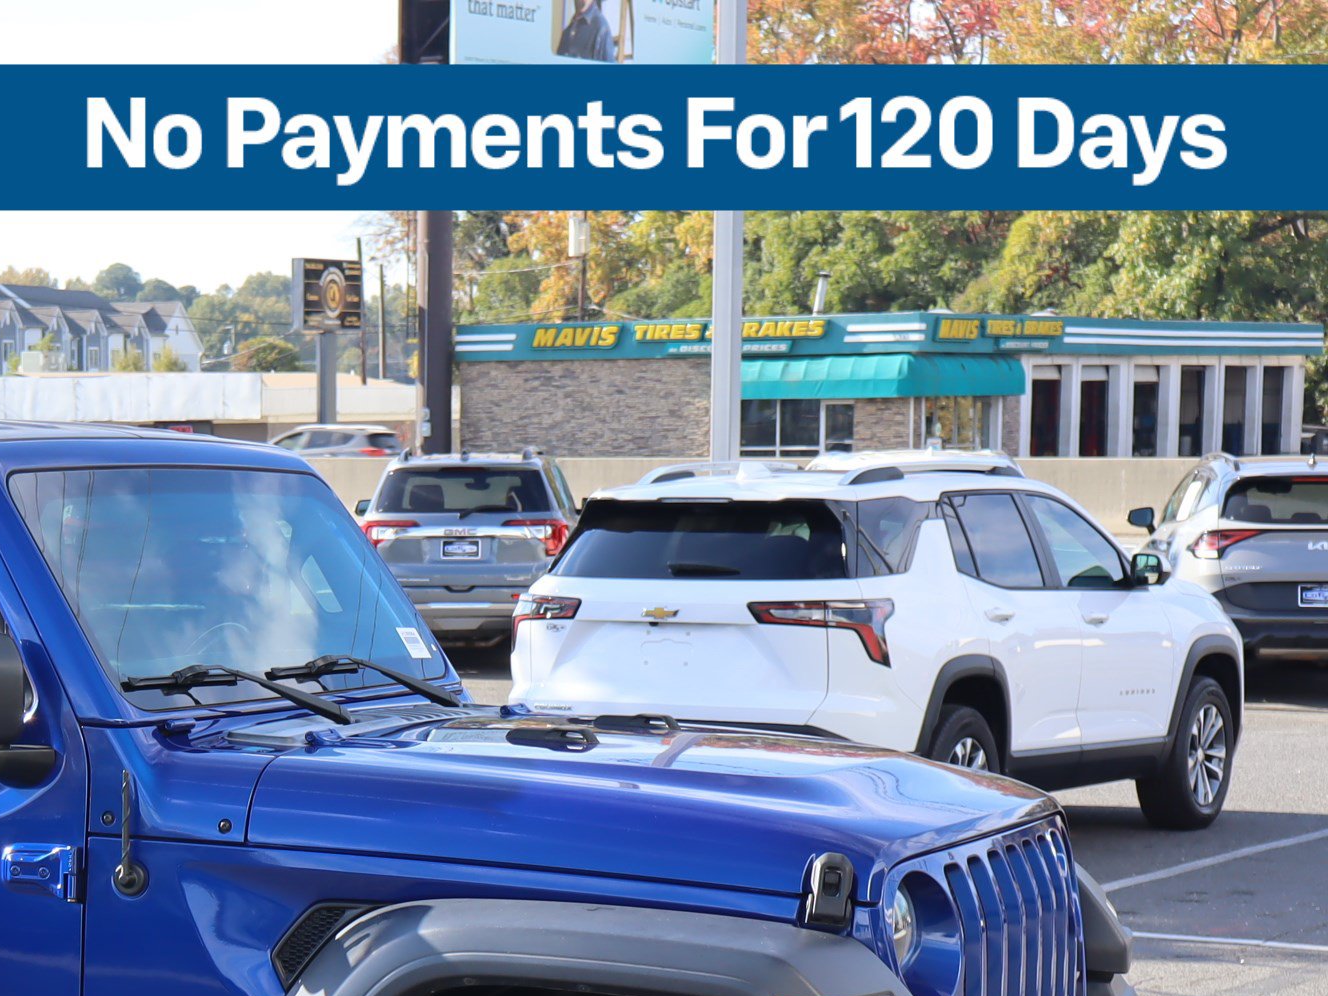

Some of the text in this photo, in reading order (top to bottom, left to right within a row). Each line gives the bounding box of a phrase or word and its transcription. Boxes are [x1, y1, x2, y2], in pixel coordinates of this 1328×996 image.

[468, 0, 537, 23] that matter
[532, 325, 620, 348] MAVIS
[633, 323, 703, 340] TIRES
[741, 320, 826, 338] RAKES
[938, 319, 980, 340] MAVIS
[986, 319, 1015, 336] TIRES
[1024, 320, 1064, 336] BRAKES
[742, 343, 788, 352] PRICES
[443, 528, 477, 537] GMC
